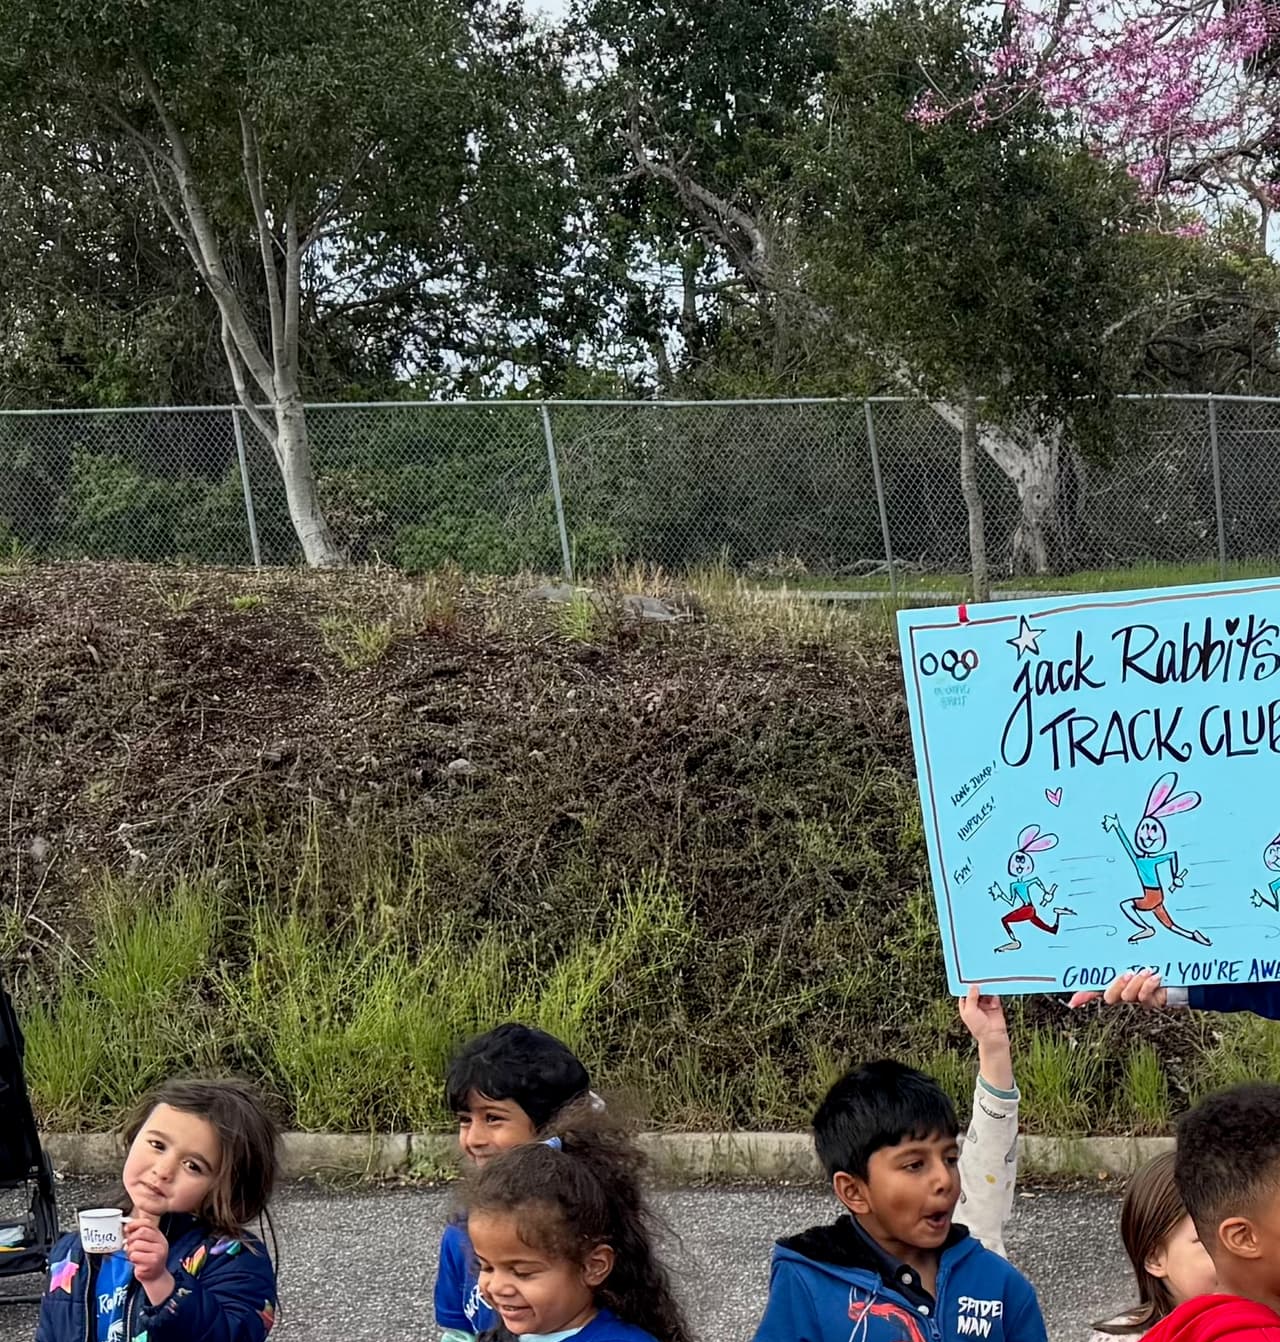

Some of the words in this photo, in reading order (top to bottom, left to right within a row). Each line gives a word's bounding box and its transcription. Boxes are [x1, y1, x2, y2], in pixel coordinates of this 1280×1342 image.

[1040, 706, 1192, 770] TRACK
[1063, 966, 1116, 988] GOOD
[1178, 959, 1244, 984] YOU'RE
[958, 1296, 1003, 1320] SPIDE
[957, 1315, 992, 1339] MAN
